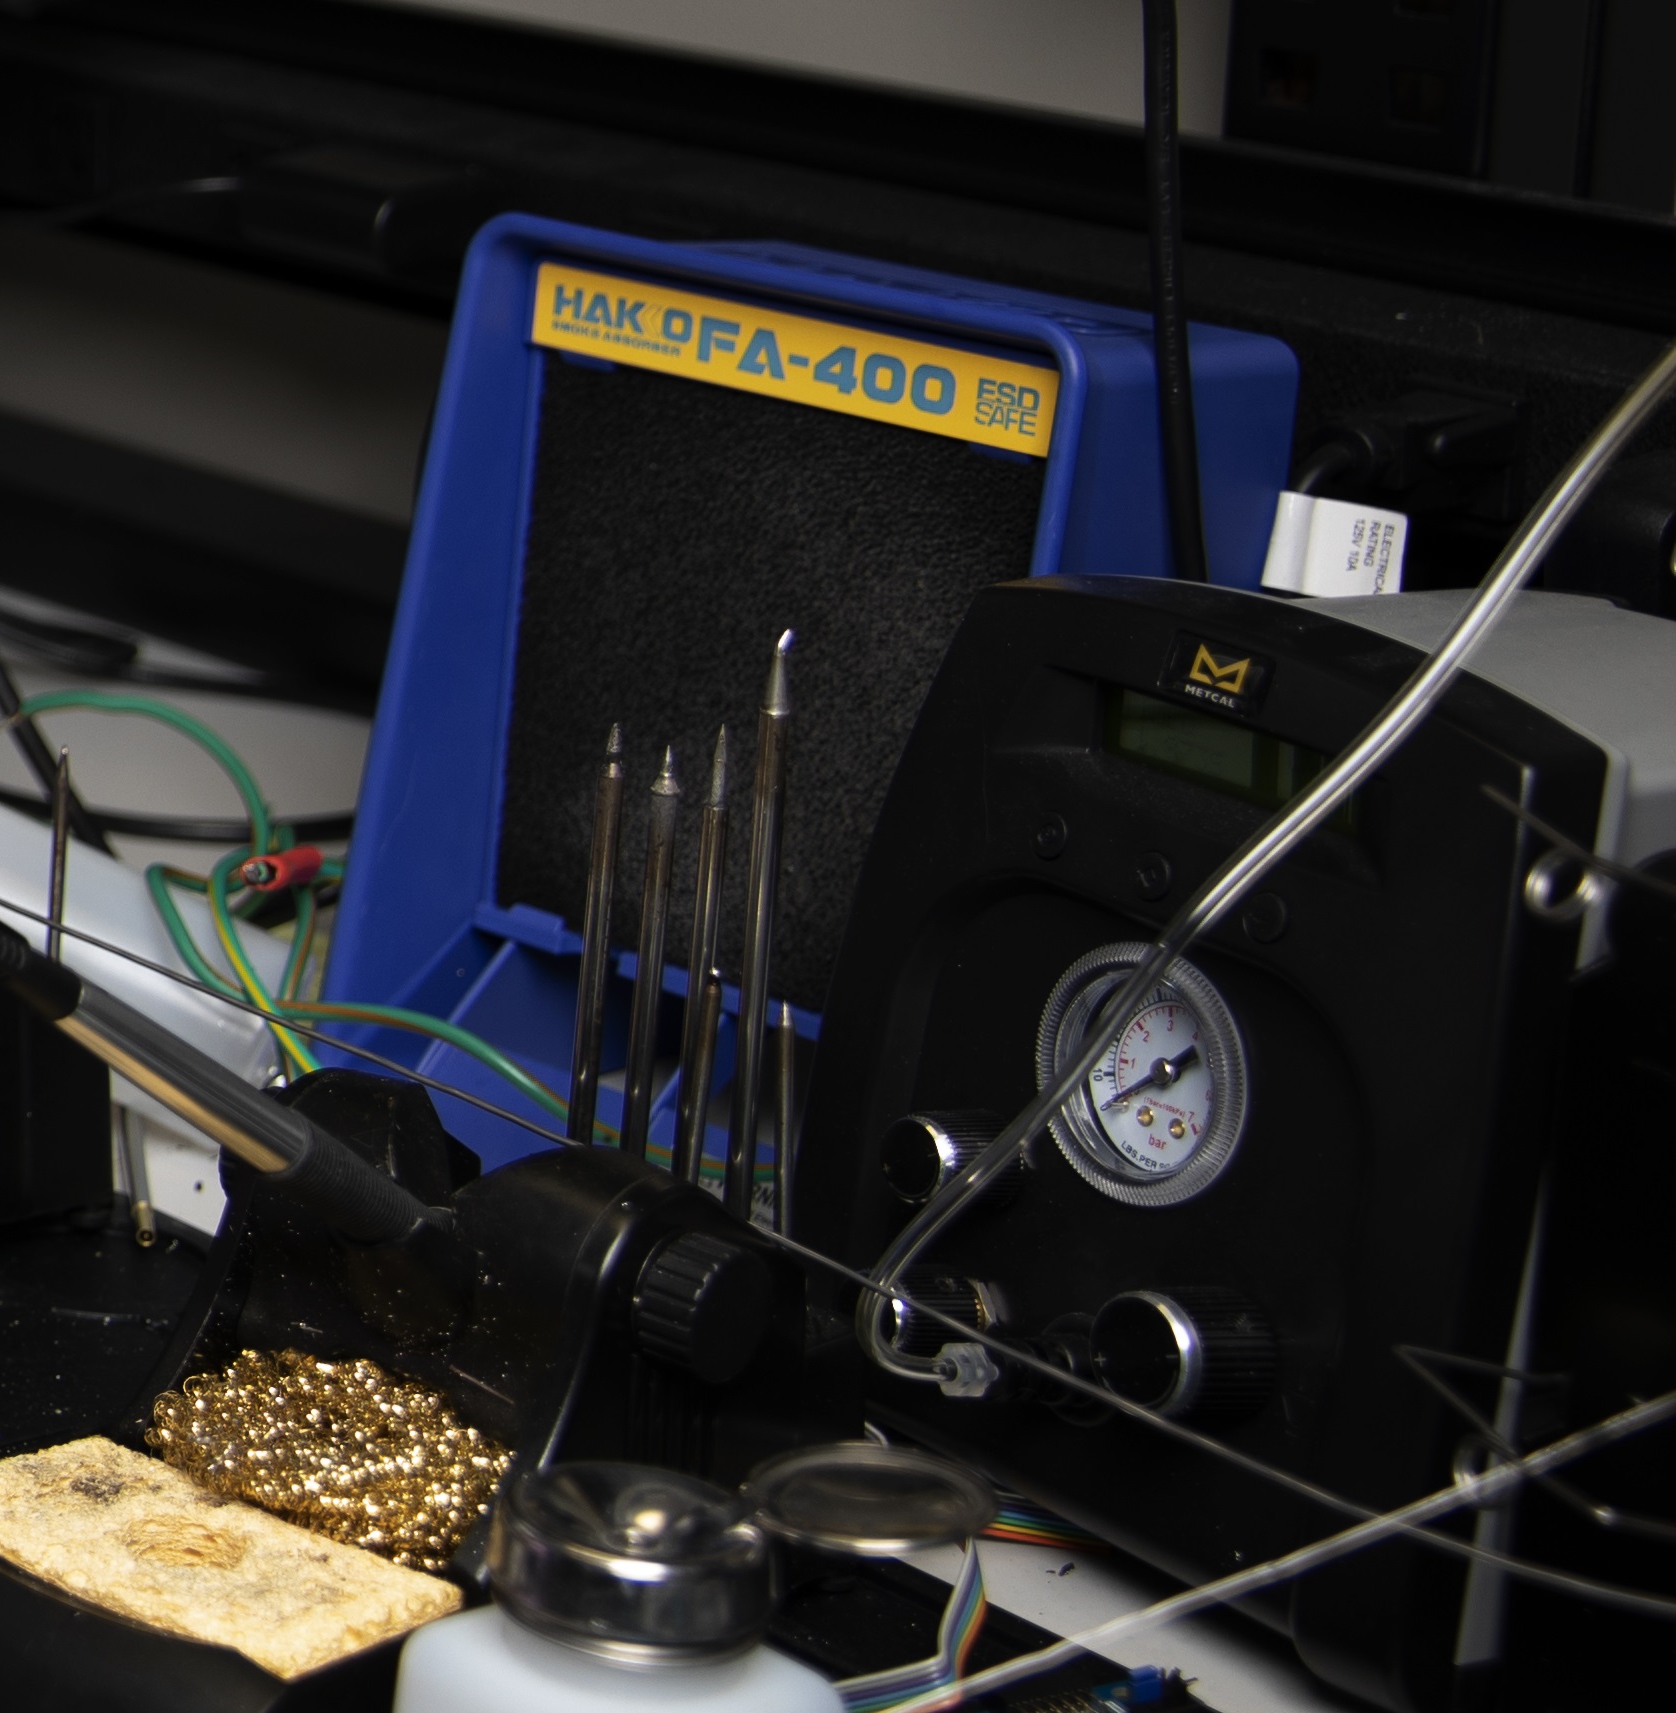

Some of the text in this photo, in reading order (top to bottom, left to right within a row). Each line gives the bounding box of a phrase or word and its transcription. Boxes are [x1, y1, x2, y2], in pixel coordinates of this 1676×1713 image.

[696, 316, 957, 416] FA-400
[976, 377, 1040, 412] ESD
[974, 401, 1037, 436] SAFE
[1346, 519, 1365, 572] 125V 10A
[1363, 521, 1381, 567] RATING
[1184, 684, 1235, 708] METCAL
[1142, 1031, 1150, 1043] 2
[1167, 1019, 1174, 1031] 3
[1092, 1068, 1104, 1082] 10
[1130, 1059, 1136, 1069] 1
[1148, 1133, 1167, 1149] bar
